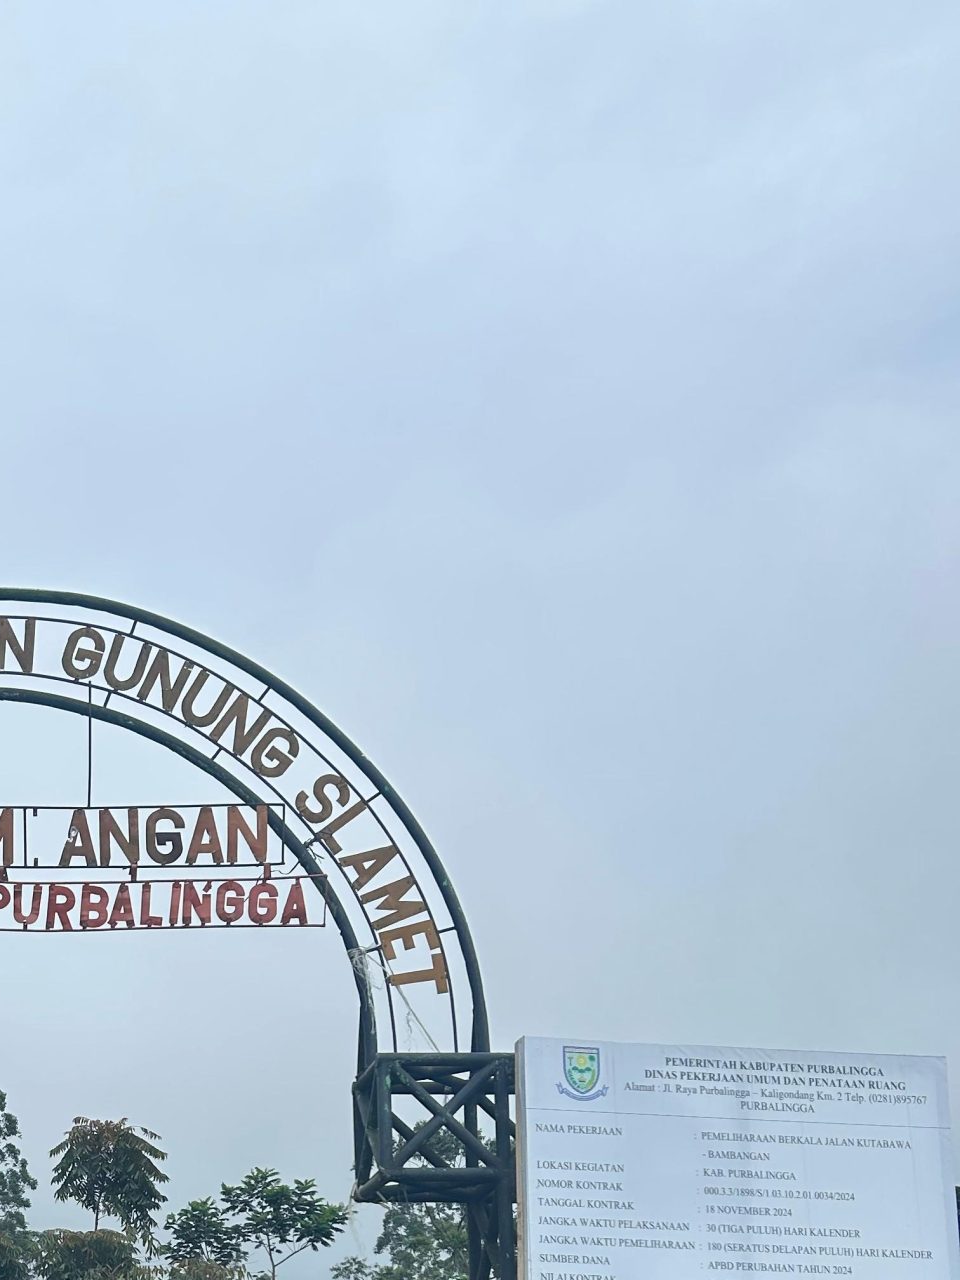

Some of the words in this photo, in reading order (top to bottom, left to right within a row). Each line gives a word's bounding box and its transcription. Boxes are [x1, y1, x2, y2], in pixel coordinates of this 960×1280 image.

[61, 626, 299, 778] GUNUNG
[295, 773, 449, 995] SLAMET
[665, 1057, 737, 1070] PEMERINTAH
[740, 1061, 804, 1073] KABUPATEN
[807, 1064, 885, 1077] PURBALINGGA
[644, 1069, 677, 1080] DINAS
[680, 1071, 743, 1083] PEKERJAAN
[746, 1075, 781, 1085] UMUM
[783, 1076, 806, 1086] DAN
[808, 1078, 865, 1089] PENATAAN
[868, 1081, 906, 1091] RUANG
[624, 1082, 655, 1092] Alamat
[676, 1085, 697, 1096] Raya
[699, 1086, 750, 1099] Purbalingga
[760, 1089, 815, 1101] Kaligondang
[837, 1091, 842, 1101] 2
[740, 1101, 815, 1113] PURBALINGGA
[535, 1123, 565, 1134] NAMA
[567, 1125, 623, 1136] PEKERJAAN
[701, 1131, 776, 1143] PEMELIHARAAN
[778, 1134, 823, 1146] BERKALA
[825, 1137, 855, 1147] JALAN
[857, 1138, 912, 1150] KUTABAWA
[537, 1160, 572, 1171] LOKASI
[574, 1162, 624, 1173] KEGIATAN
[728, 1169, 797, 1181] PURBALINGGA
[537, 1179, 573, 1189] NOMOR
[575, 1180, 623, 1191] KONTRAK
[538, 1197, 585, 1208] TANGGAL
[587, 1199, 635, 1210] KONTRAK
[706, 1205, 715, 1214] 18
[717, 1206, 771, 1216] NOVEMBER
[773, 1208, 792, 1217] 2024
[538, 1216, 578, 1227] JANGKA
[580, 1217, 616, 1228] WAKTU
[618, 1219, 690, 1231] PELAKSANAAN
[706, 1224, 716, 1233] 30
[718, 1224, 745, 1235] (TIGA
[746, 1225, 782, 1236] PULUH)
[784, 1227, 807, 1237] HARI
[809, 1228, 861, 1238] KALENDER
[539, 1234, 578, 1245] JANGKA
[580, 1236, 616, 1247] WAKTU
[619, 1238, 696, 1250] PEMELIHARAAN
[707, 1242, 722, 1251] 180
[723, 1242, 770, 1254] (SERATUS
[772, 1244, 817, 1255] DELAPAN
[819, 1246, 855, 1258] PULUH)
[856, 1247, 879, 1258] HARI
[882, 1249, 934, 1260] KALENDER
[540, 1253, 580, 1264] SUMBER
[582, 1255, 610, 1265] DANA
[708, 1261, 734, 1271] APBD
[736, 1262, 795, 1273] PERUBAHAN
[797, 1264, 830, 1274] TAHUN
[832, 1266, 852, 1275] 2024
